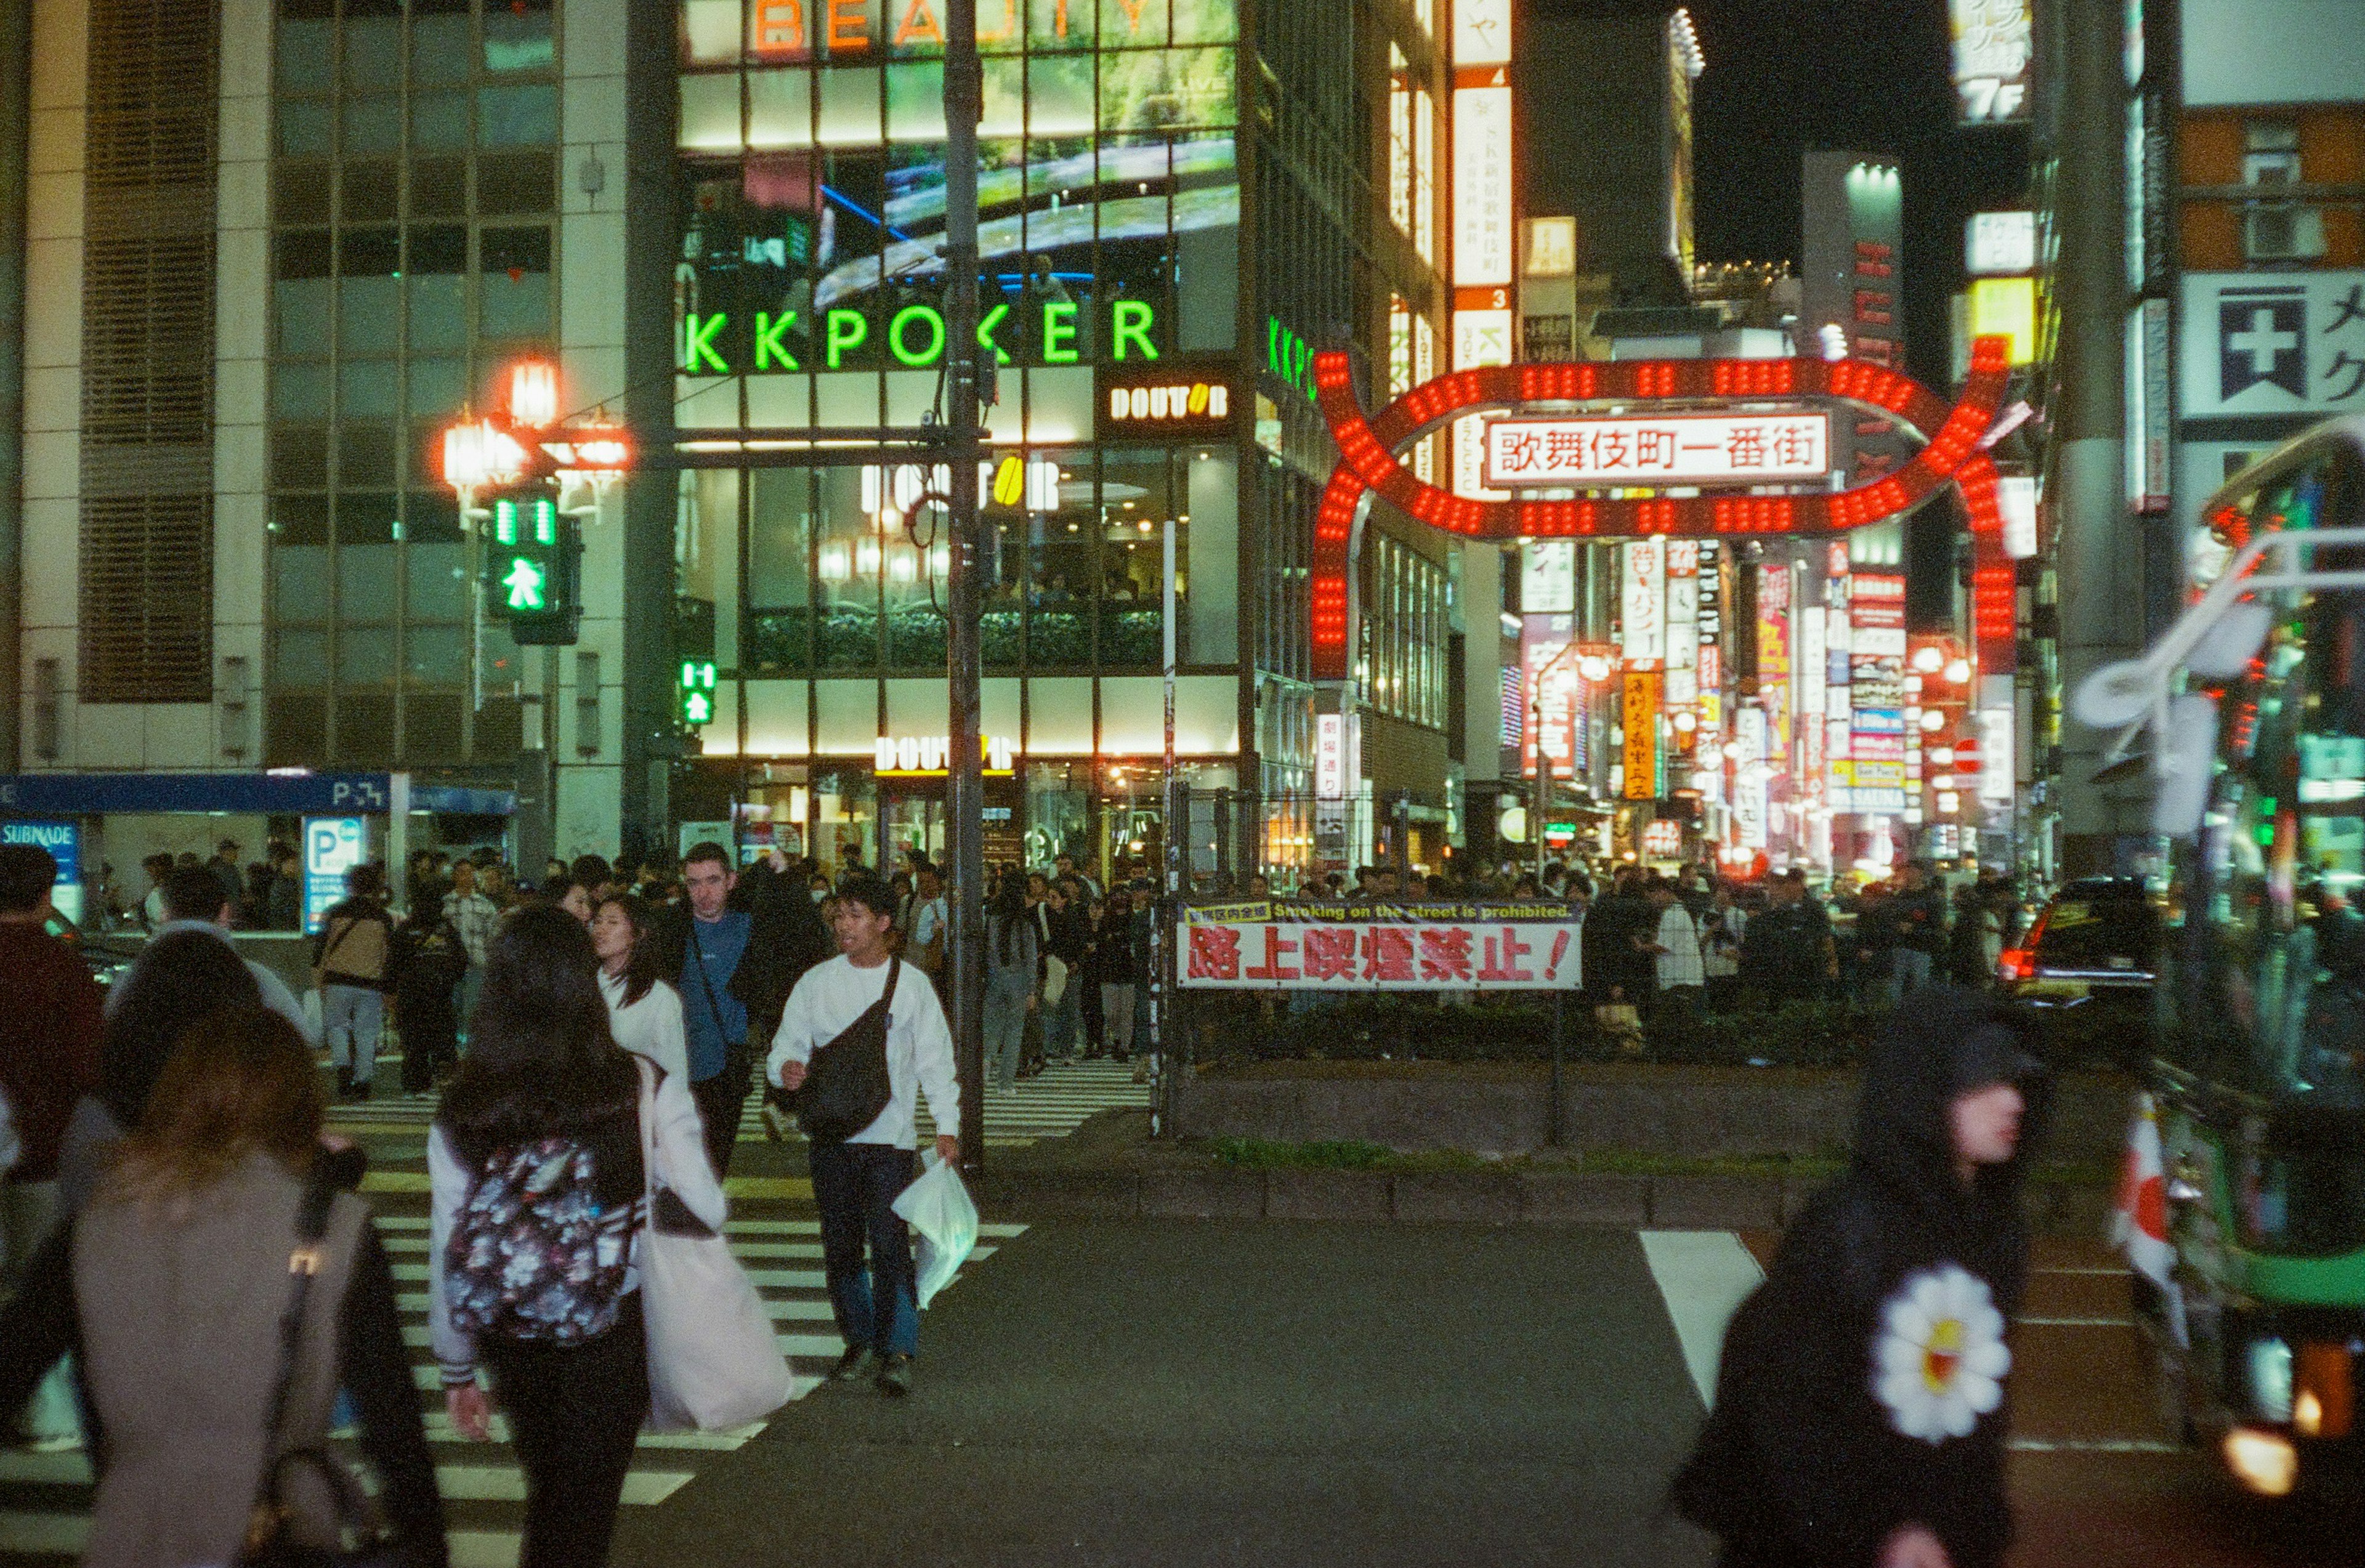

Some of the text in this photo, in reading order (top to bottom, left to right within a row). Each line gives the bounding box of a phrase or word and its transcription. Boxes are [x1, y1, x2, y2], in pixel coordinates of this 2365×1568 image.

[1491, 68, 1505, 85] 4
[1958, 79, 2024, 121] 7F
[1492, 289, 1506, 309] 3
[685, 301, 1158, 372] KKPOKER
[1111, 382, 1228, 419] DOUTOR
[1500, 424, 1817, 472] 歌舞伎町一番街
[1324, 721, 1336, 791] 劇場通り
[314, 831, 336, 868] P
[1274, 903, 1572, 921] Smoking on the street is prohibited.
